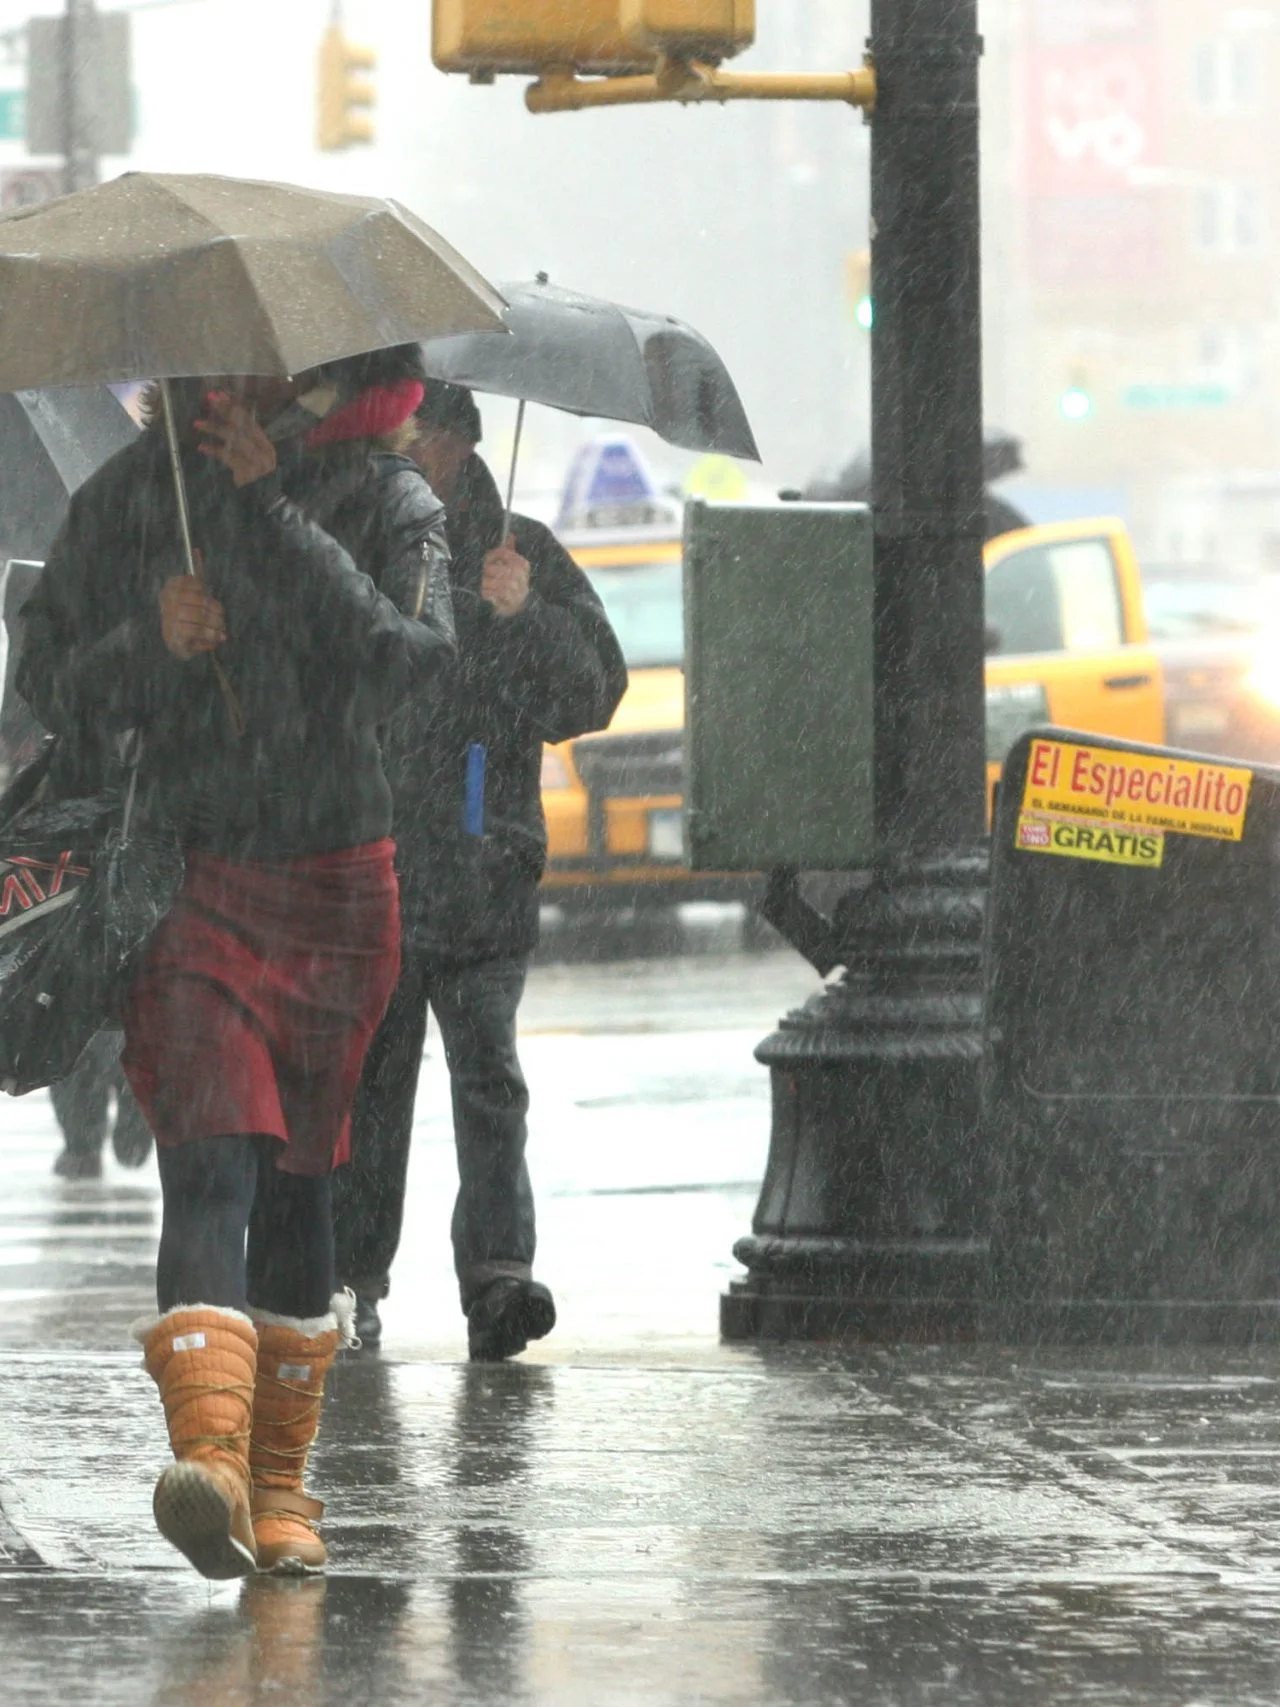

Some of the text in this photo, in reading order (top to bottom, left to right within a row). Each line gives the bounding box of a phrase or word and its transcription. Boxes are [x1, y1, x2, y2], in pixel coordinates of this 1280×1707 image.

[1031, 745, 1243, 816] El Especialito
[1054, 826, 1158, 859] GRATIS
